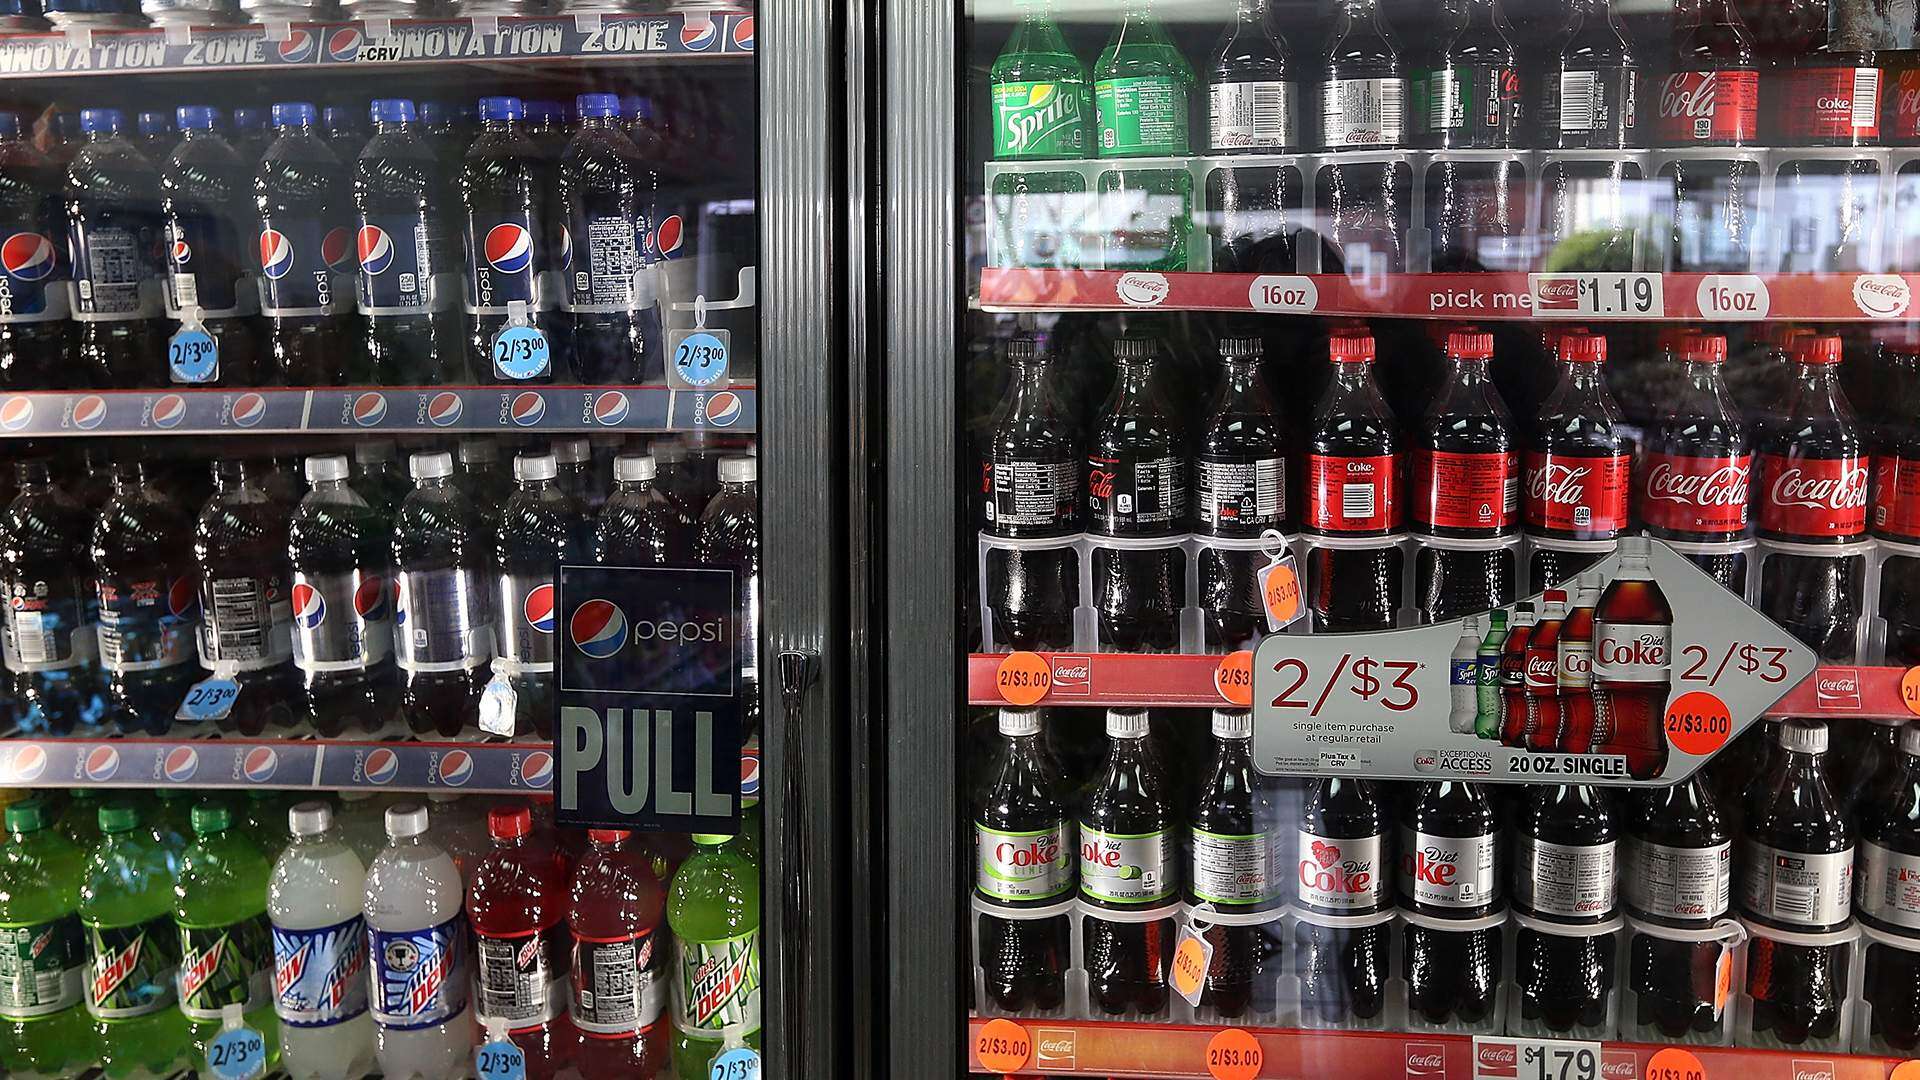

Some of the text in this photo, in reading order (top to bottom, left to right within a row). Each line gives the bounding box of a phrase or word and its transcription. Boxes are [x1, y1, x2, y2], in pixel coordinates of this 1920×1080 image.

[581, 20, 668, 54] ZONE
[184, 36, 267, 66] ZONE
[357, 47, 399, 62] +CRV
[1007, 88, 1075, 150] Sprite
[1696, 121, 1709, 130] 190
[1261, 285, 1307, 306] 16oz
[1430, 294, 1532, 316] pick me
[1579, 278, 1652, 312] $1.19
[1709, 287, 1757, 312] 16oz
[417, 394, 428, 425] pepsi
[499, 393, 511, 424] pepsi
[583, 393, 594, 424] pepsi
[694, 393, 706, 424] pepsi
[1346, 461, 1373, 474] Coke
[1575, 507, 1591, 518] 240
[634, 616, 723, 646] pepsi
[1598, 638, 1665, 666] Coke
[1000, 670, 1049, 688] 2/$3.00
[1293, 721, 1395, 737] single item purchase
[1667, 713, 1728, 735] 2/$3.00
[1305, 734, 1381, 744] at regular retail
[559, 705, 733, 818] PULL
[1320, 751, 1336, 759] Plus
[1337, 752, 1349, 760] Tax
[1439, 758, 1491, 771] ACCESS
[1440, 750, 1492, 759] EXCEPTIONAL
[428, 751, 440, 785] pepsi
[510, 752, 521, 786] pepsi
[1509, 756, 1624, 777] 20 OZ. SINGLE
[995, 842, 1059, 867] Coke
[1425, 846, 1458, 862] Diet
[1299, 860, 1372, 894] Coke
[1342, 860, 1371, 874] Diet
[979, 1037, 1027, 1058] 2/$3.00
[1210, 1048, 1260, 1068] 2/$3.00
[1524, 1046, 1597, 1080] $1.79
